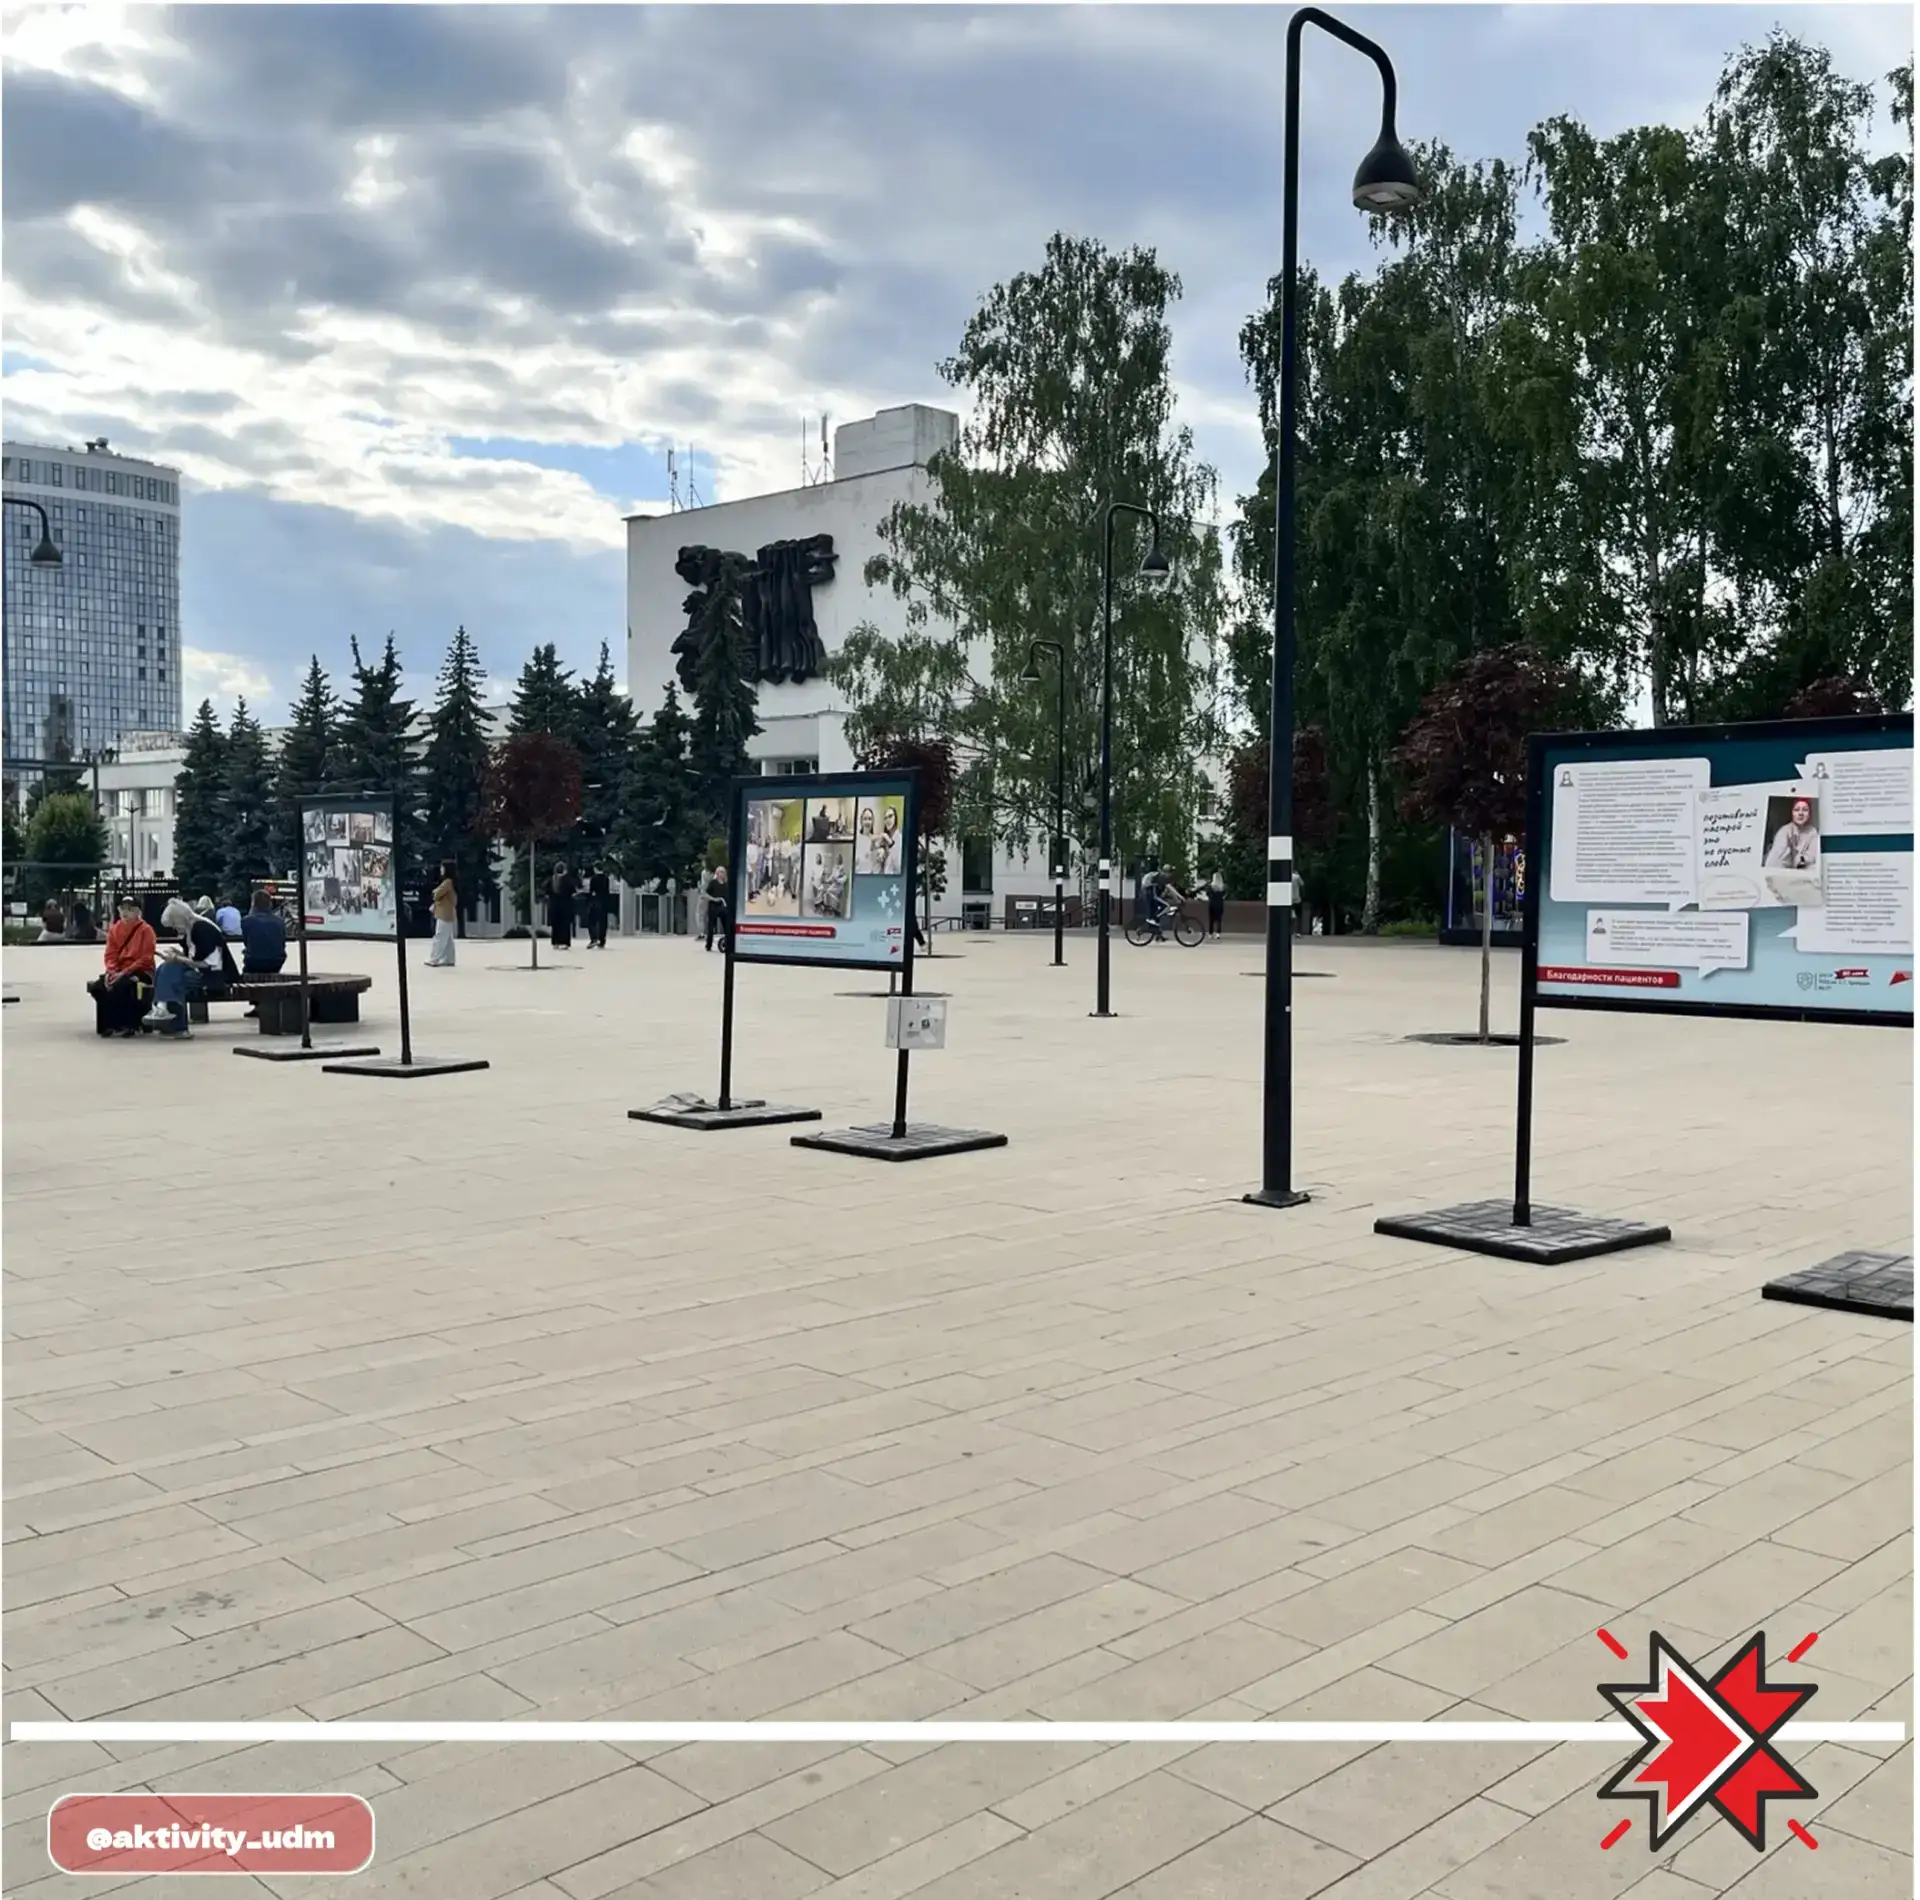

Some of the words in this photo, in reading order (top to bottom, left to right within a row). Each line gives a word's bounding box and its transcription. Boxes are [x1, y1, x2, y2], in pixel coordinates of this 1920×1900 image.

[1703, 822, 1742, 834] настрой
[1703, 837, 1720, 845] это
[1717, 847, 1751, 860] пустые
[1704, 858, 1730, 869] слова
[1546, 970, 1613, 983] Благодарности
[1615, 974, 1664, 984] пациентов
